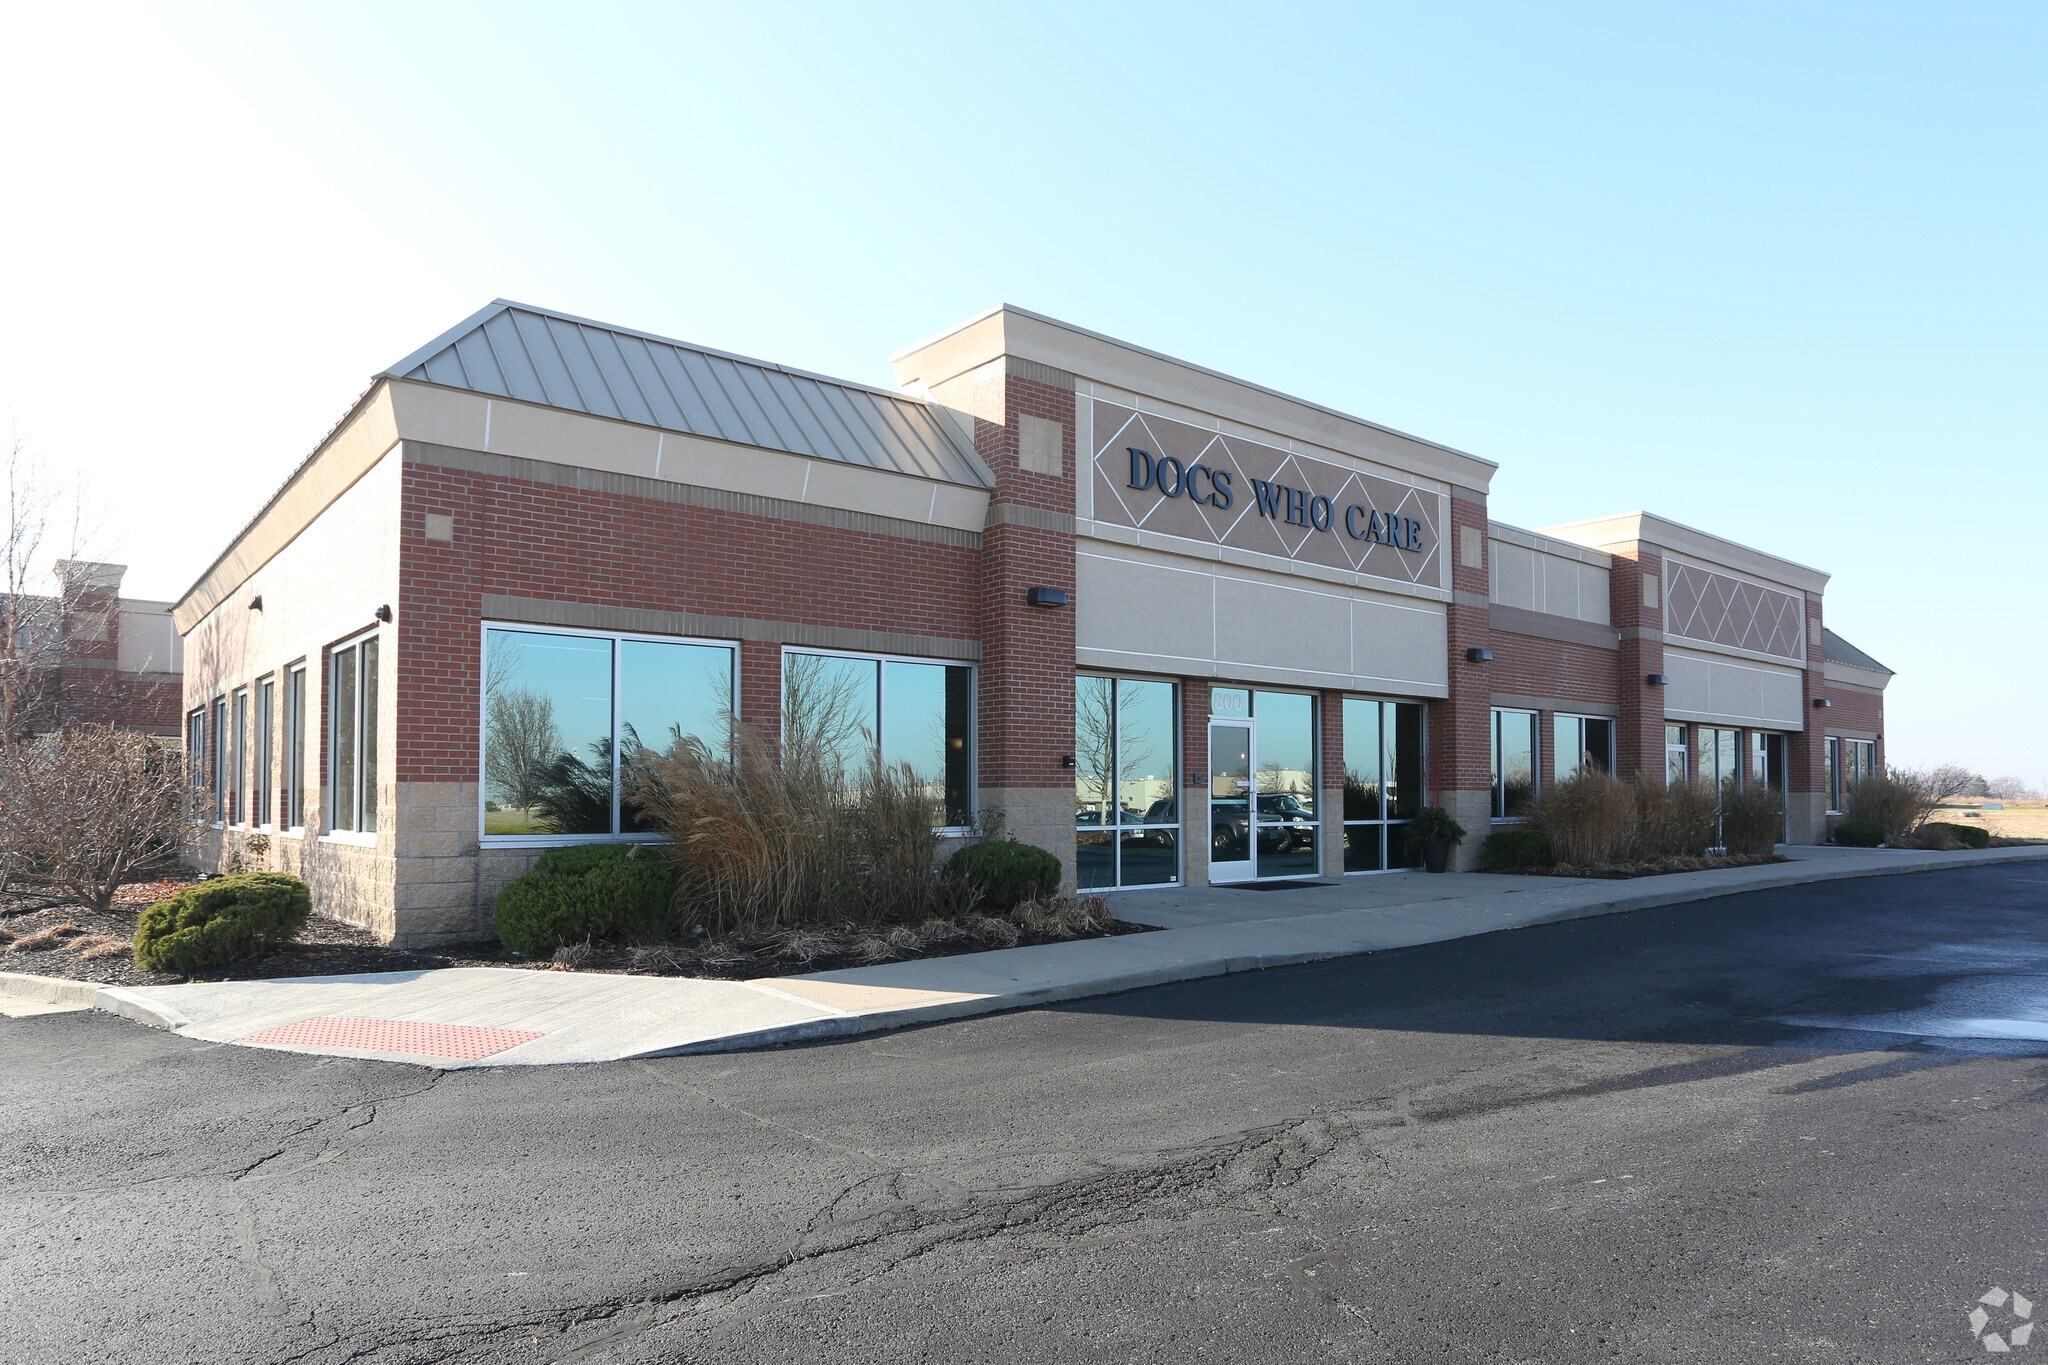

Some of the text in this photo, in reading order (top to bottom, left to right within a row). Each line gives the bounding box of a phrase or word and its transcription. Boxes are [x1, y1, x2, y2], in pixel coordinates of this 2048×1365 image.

[1126, 447, 1423, 552] DOCS WHO CARE
